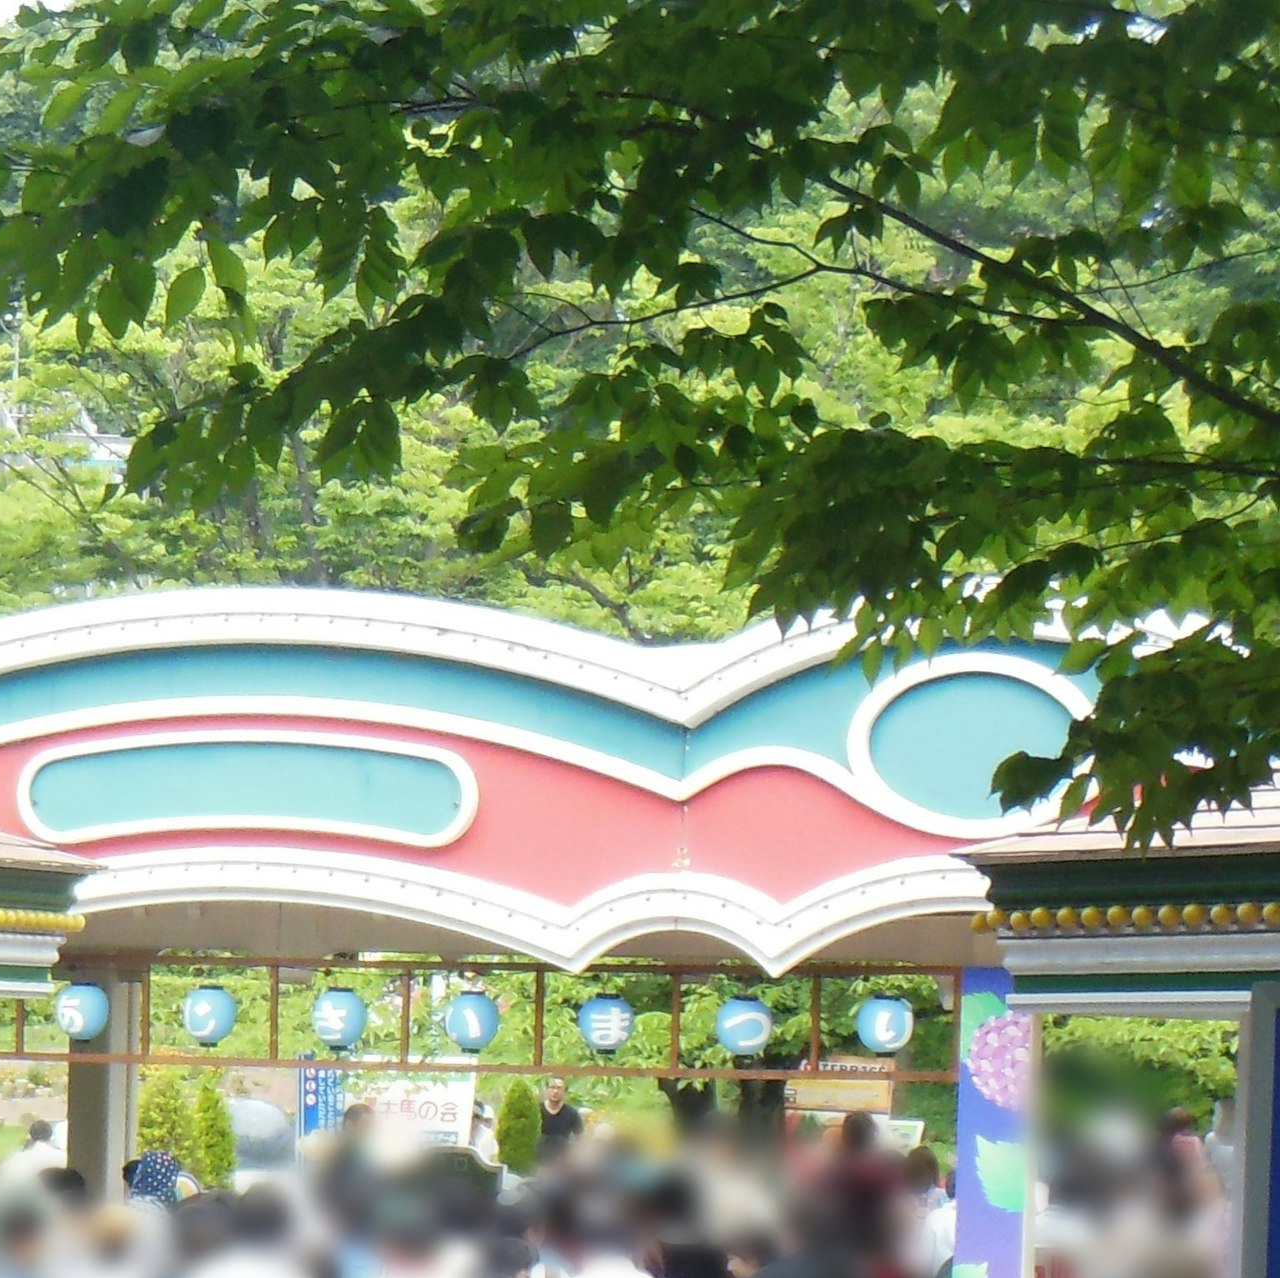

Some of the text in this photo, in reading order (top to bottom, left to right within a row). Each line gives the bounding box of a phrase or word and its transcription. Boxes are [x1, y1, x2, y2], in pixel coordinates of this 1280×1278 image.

[590, 1006, 631, 1046] ま
[723, 1011, 772, 1047] つ
[874, 999, 914, 1048] り
